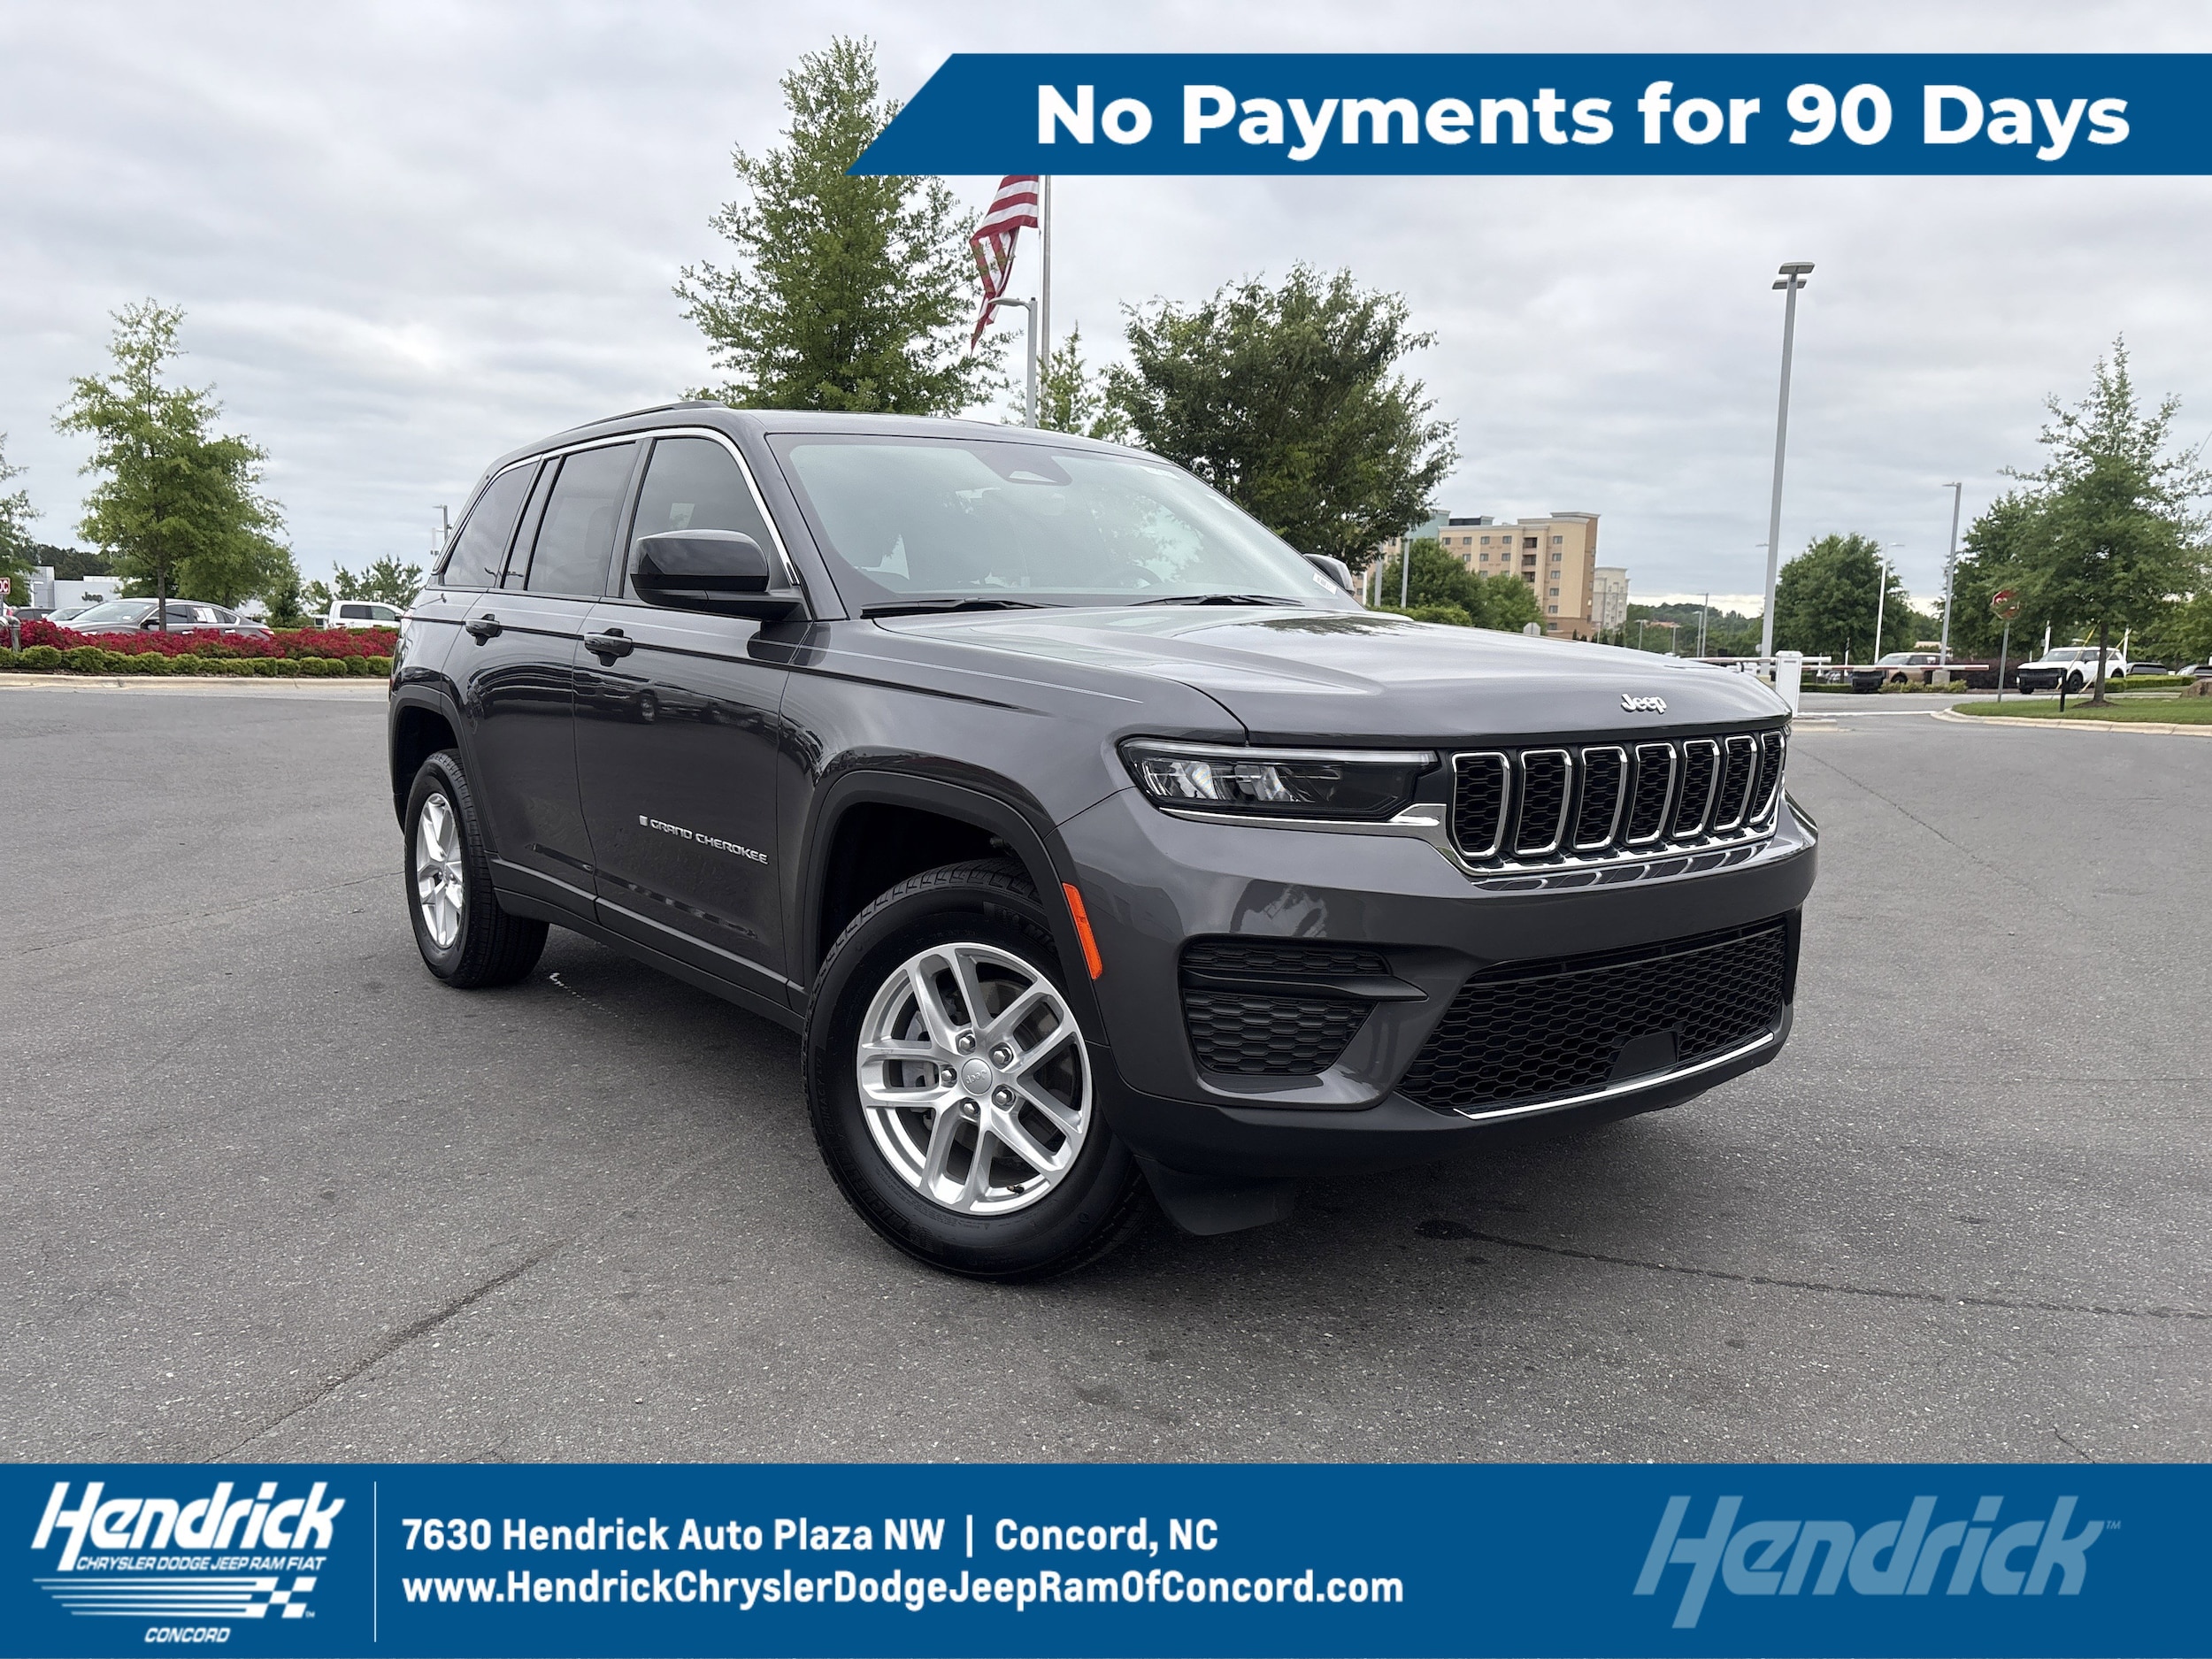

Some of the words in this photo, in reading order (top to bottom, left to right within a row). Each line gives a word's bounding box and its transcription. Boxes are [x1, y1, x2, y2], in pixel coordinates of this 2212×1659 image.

[81, 591, 104, 603] Jeep
[1621, 694, 1667, 714] Jeep
[649, 818, 693, 840] GRAND
[695, 833, 769, 865] CHEROKEE
